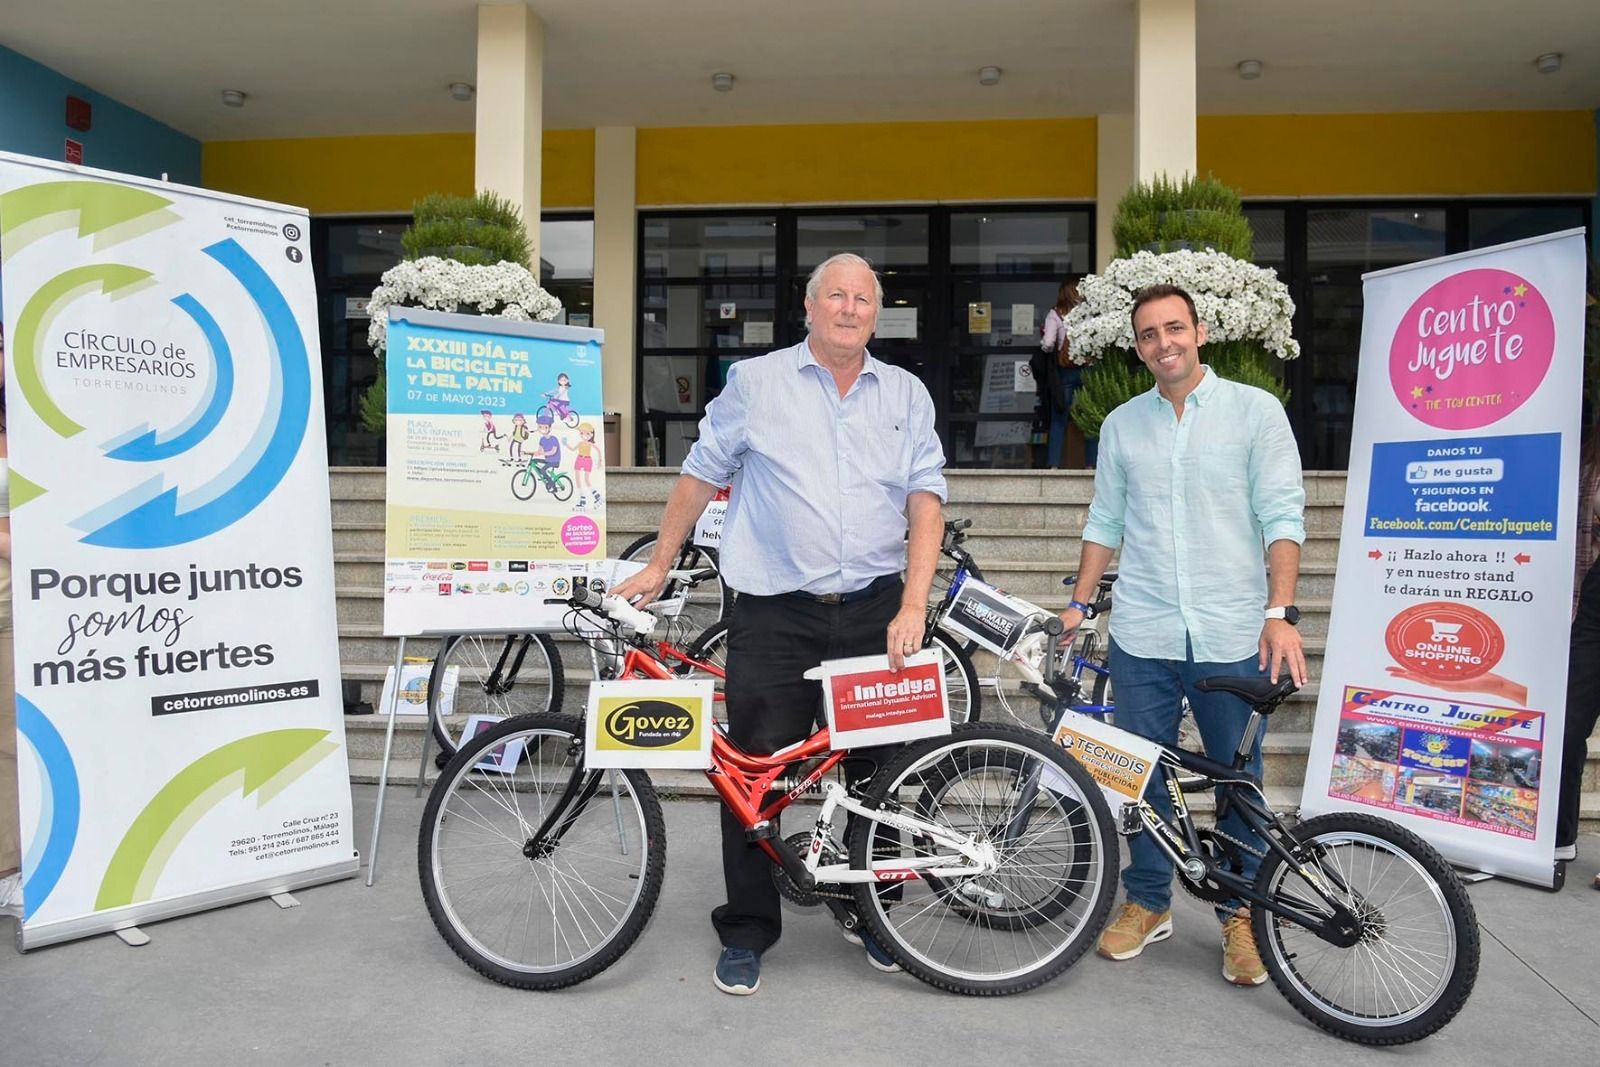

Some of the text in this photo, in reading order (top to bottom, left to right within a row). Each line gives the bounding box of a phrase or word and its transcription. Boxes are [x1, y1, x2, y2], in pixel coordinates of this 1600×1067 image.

[1418, 295, 1516, 338] Centro
[64, 329, 186, 360] CÍRCULO de
[408, 336, 528, 360] XXXIII DÍA DE
[1408, 326, 1523, 380] Juguete
[56, 352, 196, 378] EMPRESARIOS
[407, 356, 532, 378] LA BICICLETA
[73, 378, 187, 394] TORREMOLINOS
[407, 372, 522, 394] Y DEL PATÍN
[408, 390, 422, 400] 07
[442, 394, 473, 404] MAYO
[478, 396, 506, 407] 2023
[1425, 393, 1502, 410] THE TOY CENTER
[1428, 446, 1482, 456] DANOS TU
[1433, 467, 1493, 480] Me gusta
[1422, 486, 1476, 495] SIGUENOS
[1480, 486, 1494, 494] EN
[1370, 517, 1552, 534] Facebook.com/CentroJuguete
[1404, 549, 1442, 561] Hazlo
[1446, 551, 1488, 562] ahora
[30, 564, 302, 602] Porque juntos
[1386, 568, 1515, 582] y en nuestro stand
[1384, 585, 1533, 602] te darán un REGALO
[58, 604, 194, 655] somos
[1405, 649, 1481, 664] SHOPPING
[1416, 642, 1472, 655] ONLINE
[33, 641, 274, 686] más fuertes
[163, 684, 308, 712] cetorremolinos.es
[854, 678, 936, 701] Intedya
[841, 692, 937, 710] International Dynamic Advisors
[1352, 692, 1533, 729] CENTRO JUGUETE
[610, 705, 690, 740] Govez
[1366, 716, 1516, 744] www.centrojuguete.com
[1077, 738, 1145, 775] TECNIDÍS
[283, 820, 301, 828] Calle
[303, 816, 319, 824] Cruz
[232, 837, 256, 847] 29620
[262, 828, 312, 841] Torremolinos,
[314, 822, 339, 831] Málaga
[229, 848, 247, 856] Tels:
[276, 839, 290, 848] 246
[256, 839, 339, 860] cet@cetorremolinos.es
[879, 870, 908, 880] GTT
